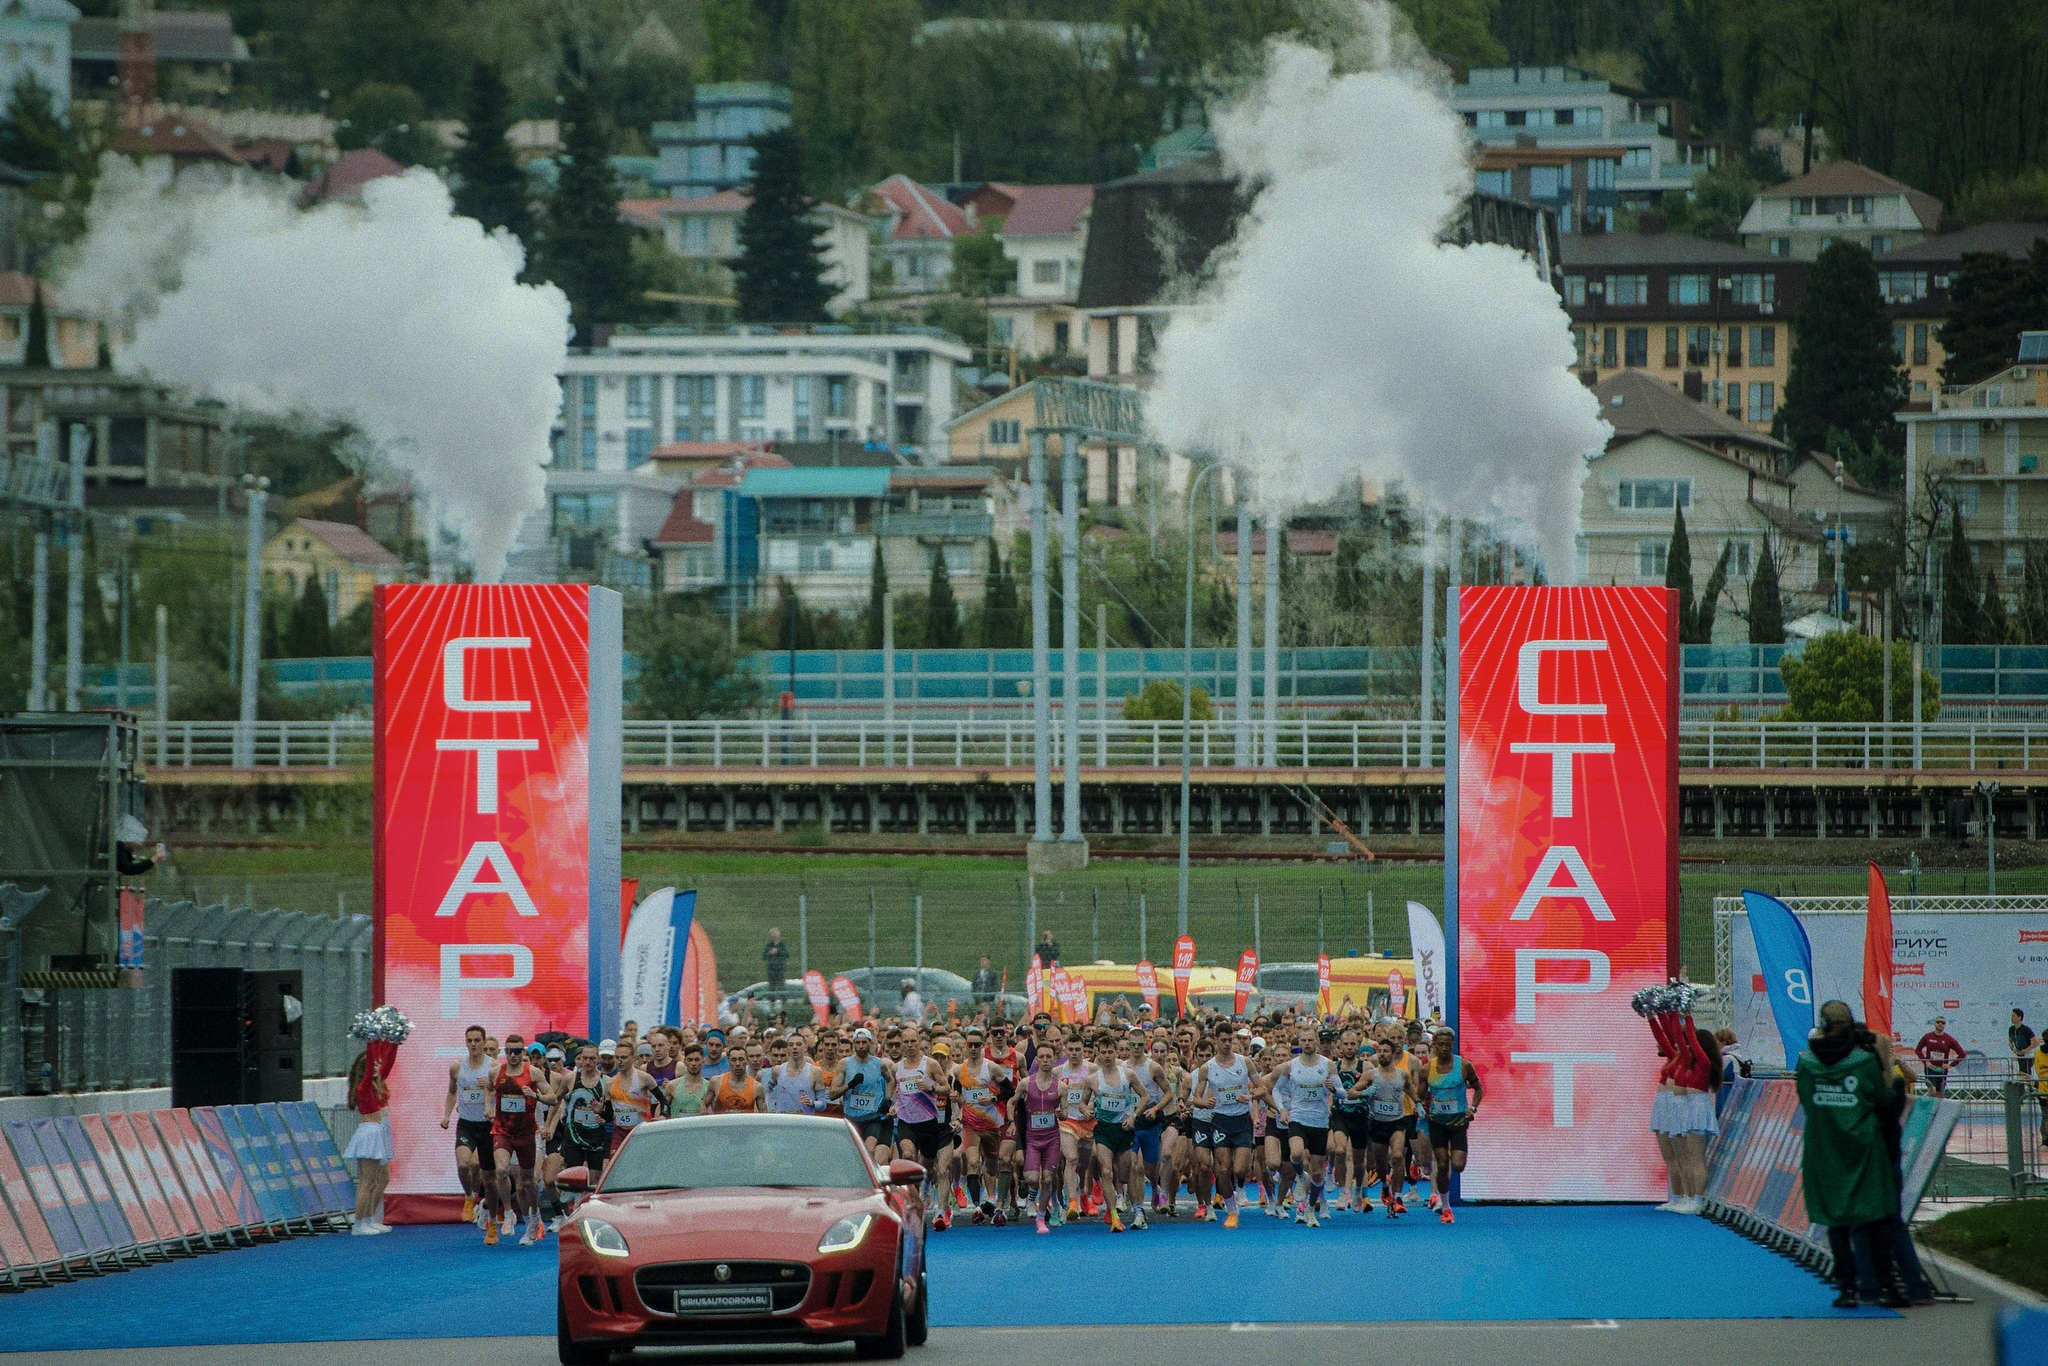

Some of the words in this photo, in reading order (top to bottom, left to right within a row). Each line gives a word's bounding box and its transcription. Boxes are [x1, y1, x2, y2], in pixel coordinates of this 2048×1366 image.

[1509, 639, 1616, 1128] СТАРТ
[1892, 938, 1948, 949] РИУС
[1069, 1092, 1081, 1100] 29
[1225, 1092, 1237, 1101] 95
[1306, 1090, 1317, 1098] 75
[508, 1101, 518, 1109] 71
[1107, 1101, 1119, 1109] 117
[1379, 1103, 1394, 1112] 109
[620, 1115, 631, 1123] 45
[1039, 1117, 1048, 1125] 19
[680, 1296, 768, 1306] SIRIUSAUTODROM.RU
